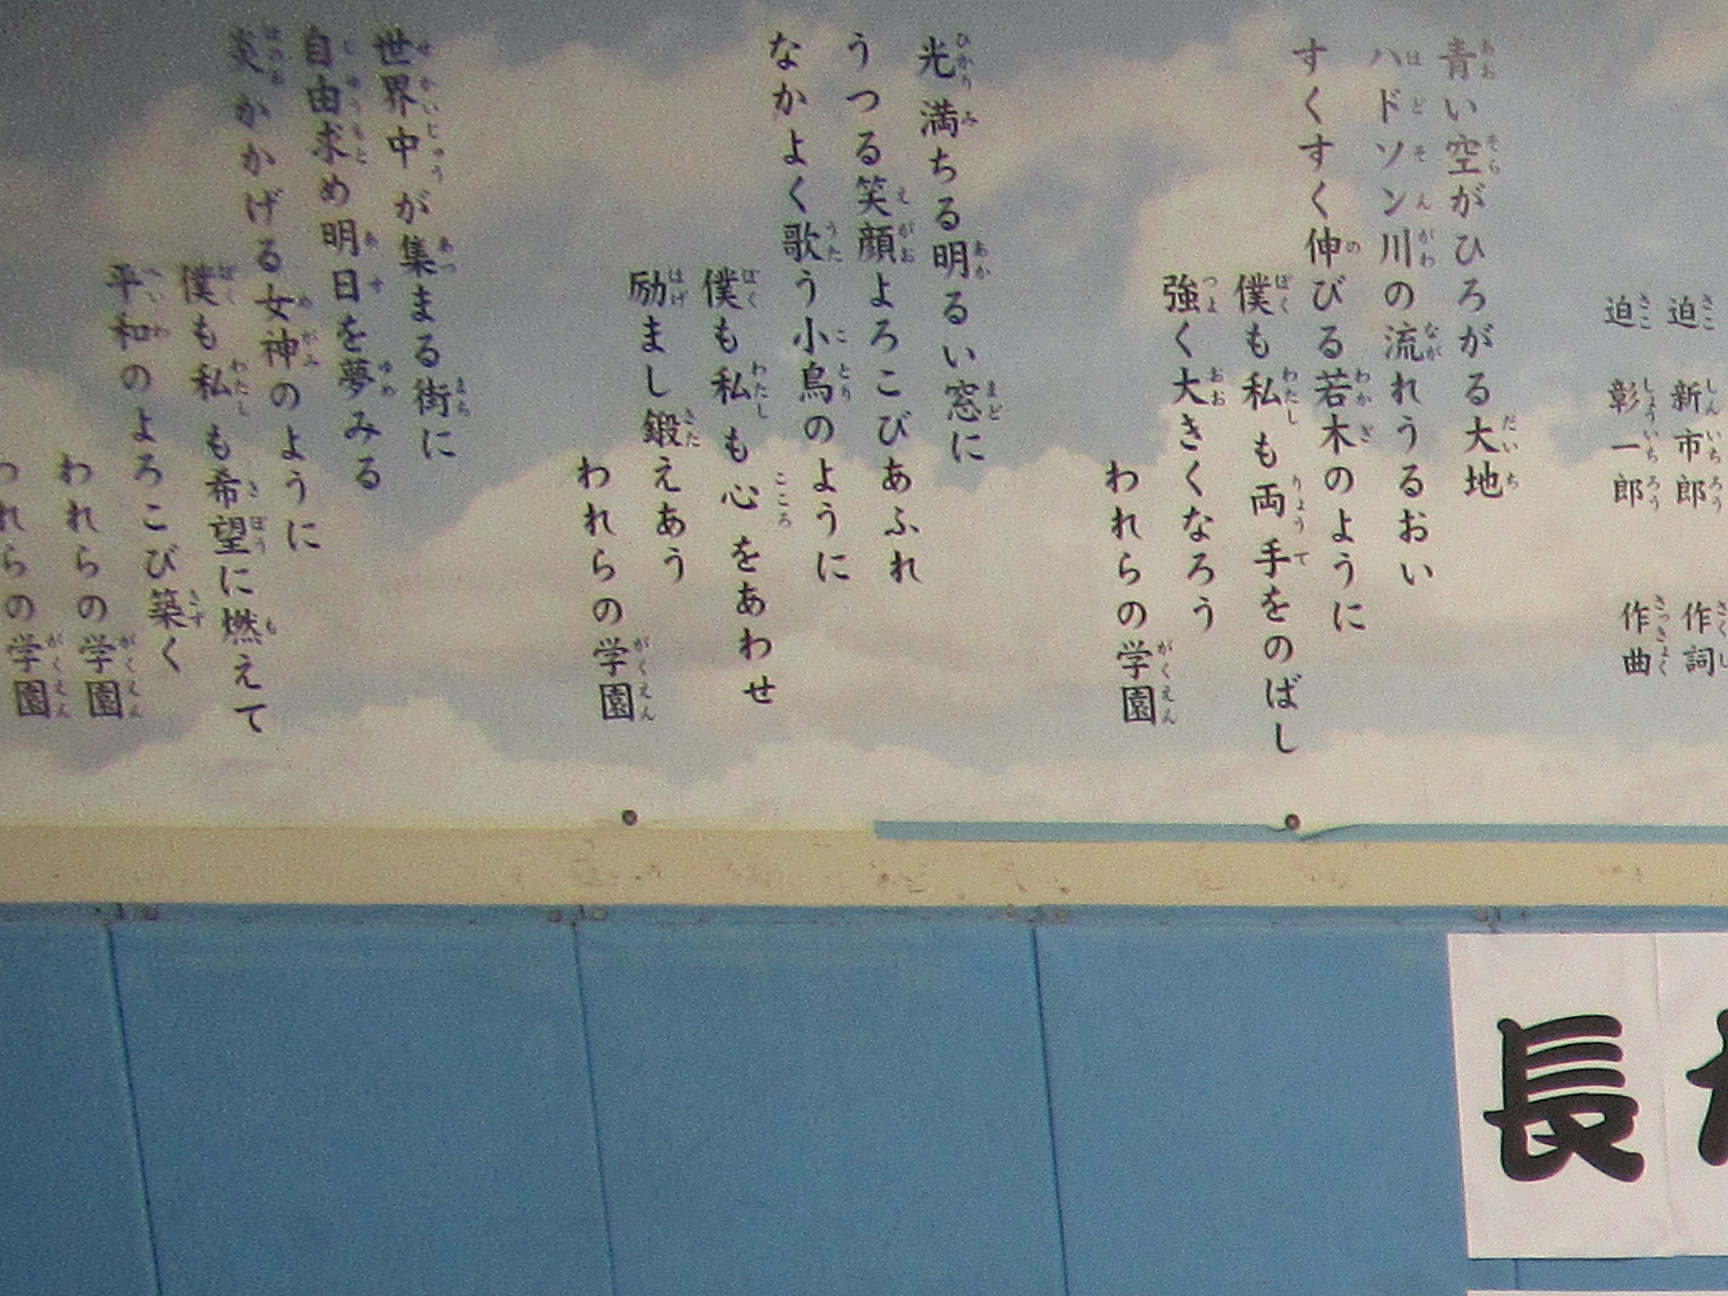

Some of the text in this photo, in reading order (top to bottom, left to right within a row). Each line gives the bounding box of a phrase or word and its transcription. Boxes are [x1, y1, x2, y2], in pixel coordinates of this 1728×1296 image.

[768, 32, 850, 583] なかよく歌う小鳥のように
[919, 35, 984, 464] 光満ちる明るい窓に
[1294, 39, 1366, 633] すくすく伸びる若木のように
[1439, 37, 1503, 499] 青い空がひろがる大地
[1604, 294, 1636, 327] 迫
[578, 457, 635, 722] われらの学園
[702, 267, 776, 706] 僕も私も心をあわせ
[1105, 460, 1157, 726] われらの学園
[1163, 273, 1215, 632] 強く大きくなろう
[1235, 272, 1298, 754] 僕も私も両手をのばし
[1619, 600, 1651, 676] 作曲
[1667, 295, 1715, 677] 迫 新市郎 作詞
